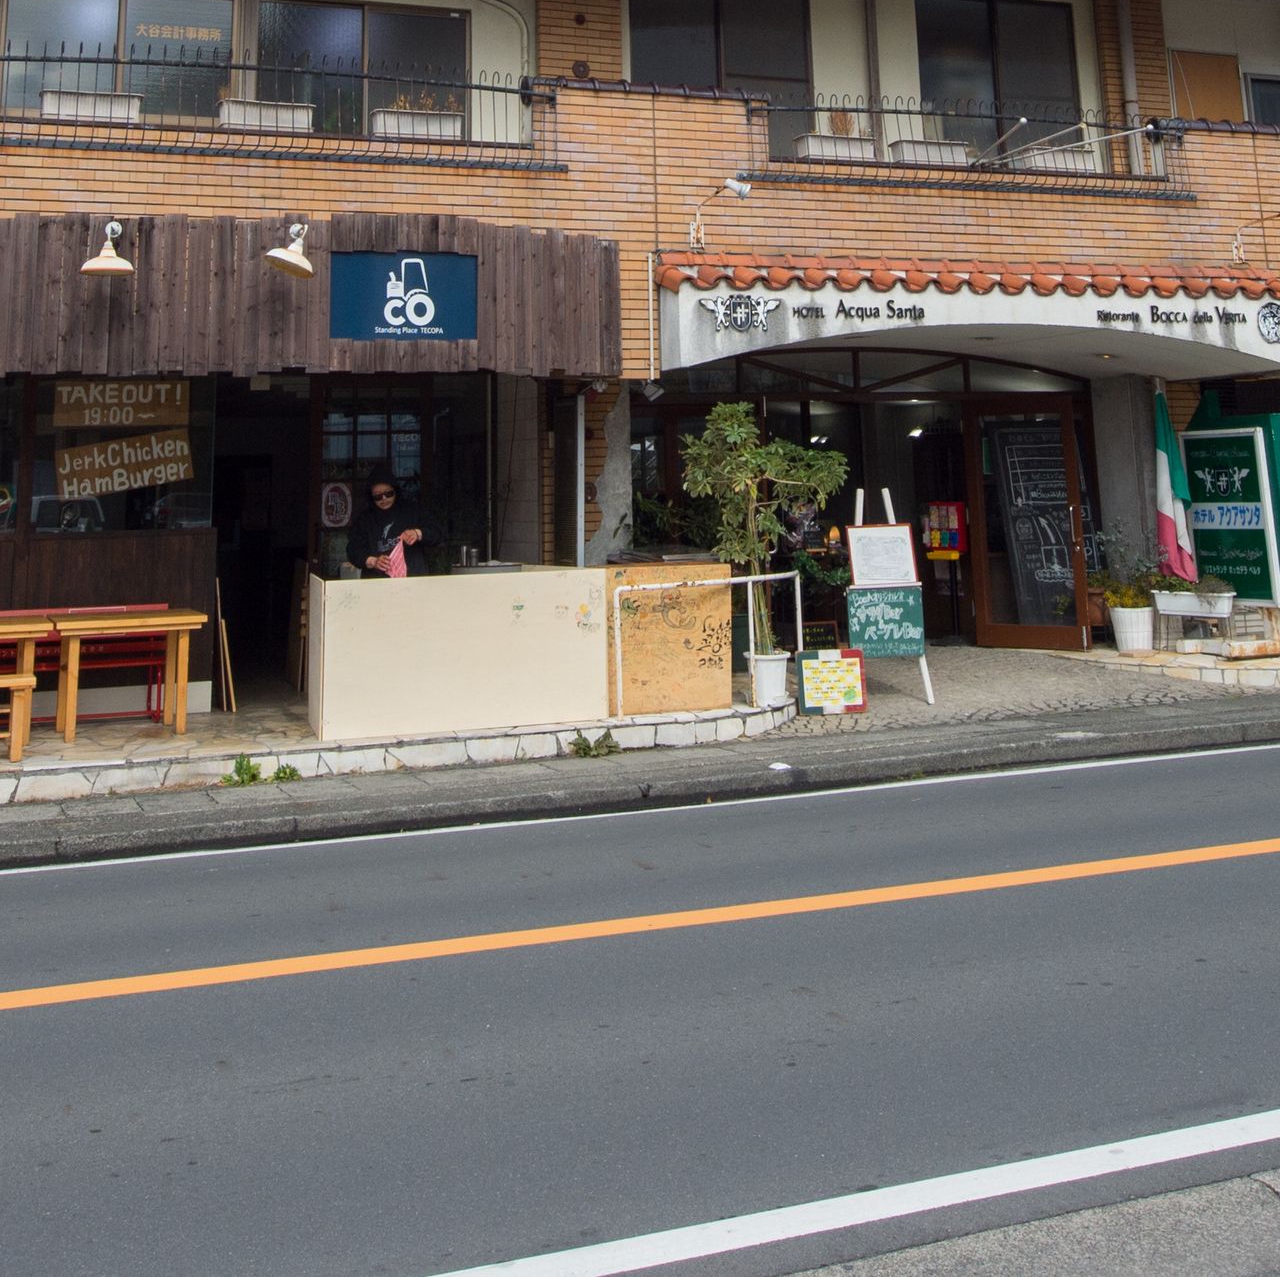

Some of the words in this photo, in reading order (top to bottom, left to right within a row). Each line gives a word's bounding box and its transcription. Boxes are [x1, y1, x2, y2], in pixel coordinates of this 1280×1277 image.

[136, 23, 222, 42] 大谷会計事務所
[792, 305, 826, 320] HOTEL
[835, 298, 881, 323] Acqua
[886, 299, 926, 321] Santa
[1096, 309, 1140, 323] Ristorante
[1193, 310, 1213, 324] della
[374, 326, 402, 335] Standing
[402, 326, 418, 334] Place
[420, 326, 444, 335] TECOPA
[1193, 509, 1215, 523] ホテル
[1217, 505, 1261, 526] アクアサンタ
